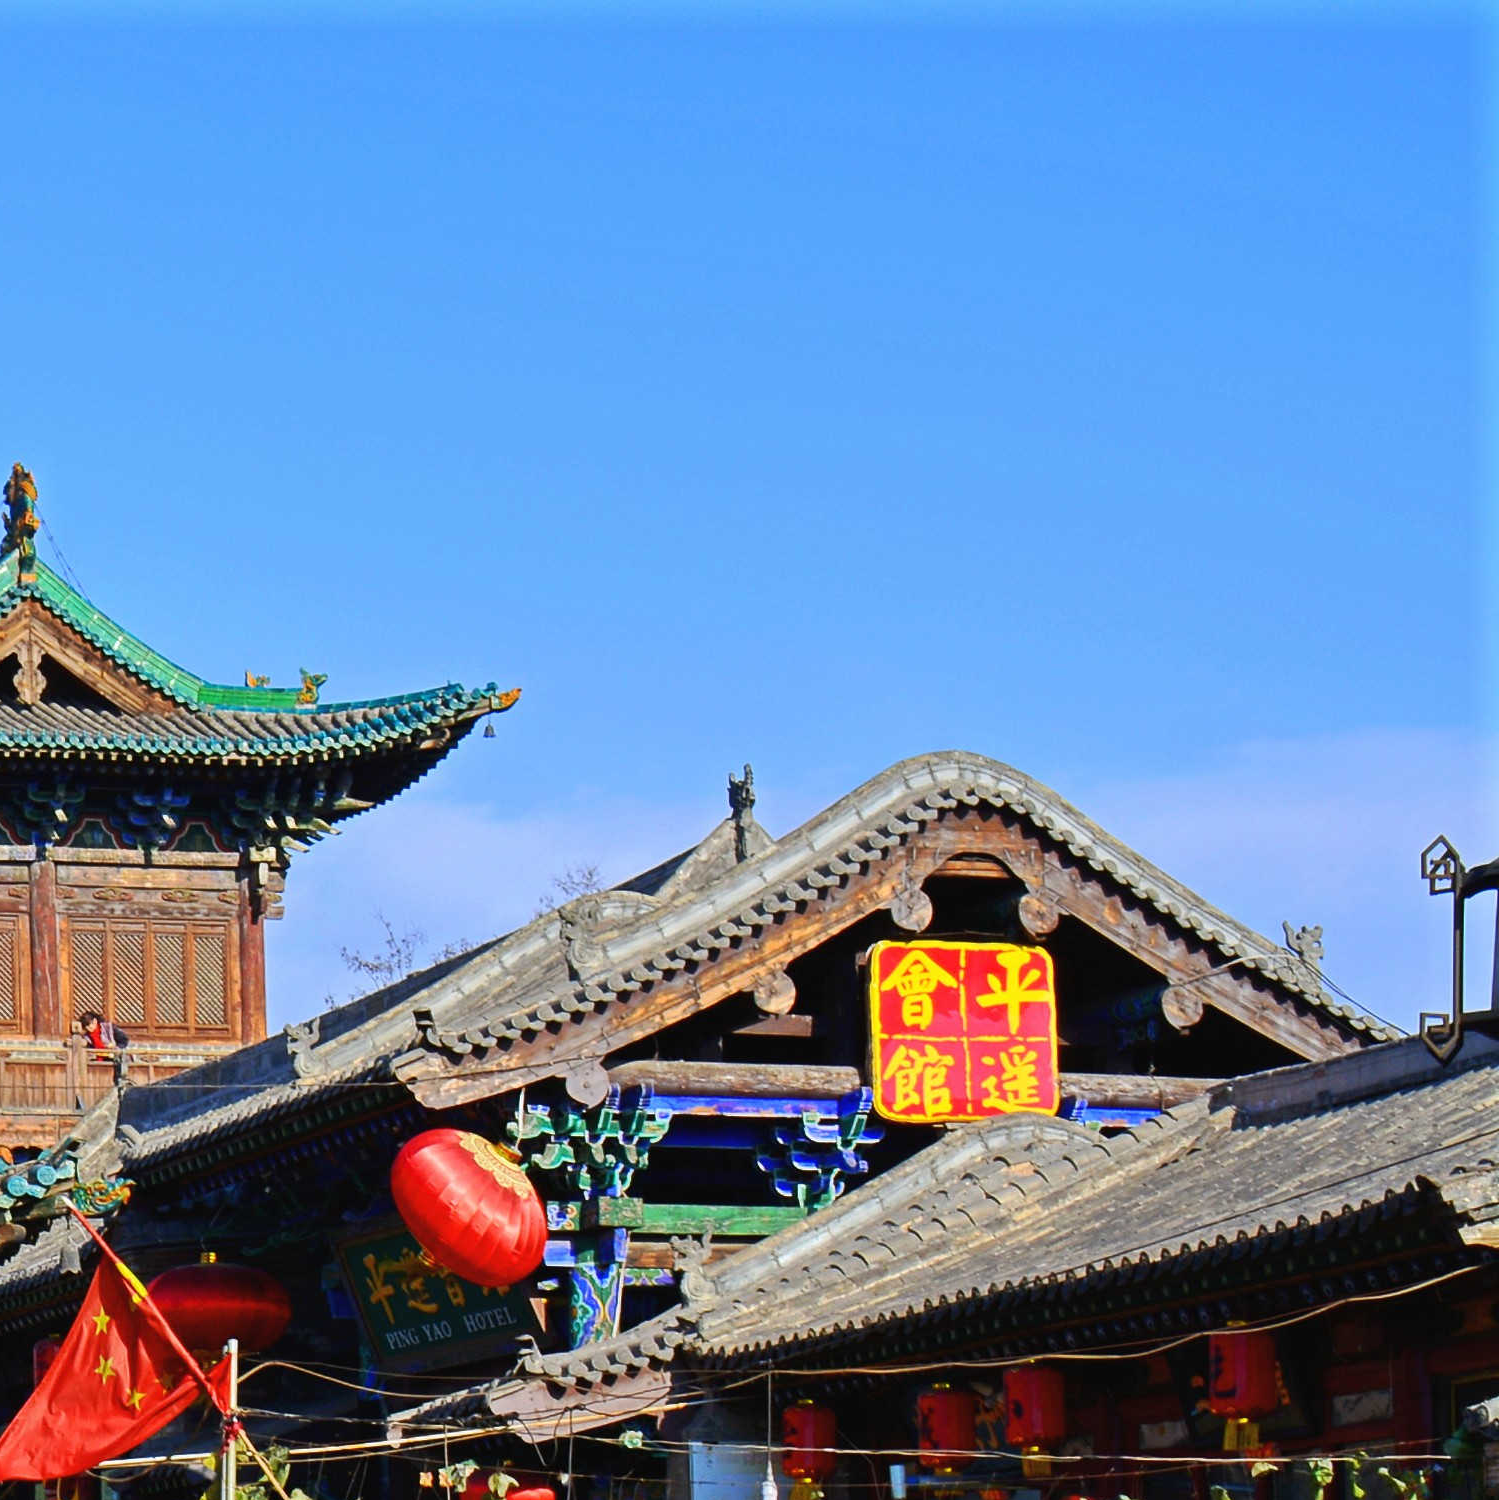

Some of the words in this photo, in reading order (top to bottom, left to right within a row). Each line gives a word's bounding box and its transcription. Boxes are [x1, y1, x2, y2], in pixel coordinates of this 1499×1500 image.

[881, 946, 959, 1117] 會館
[974, 947, 1051, 1114] 平遥
[385, 1328, 420, 1350] PING
[422, 1319, 452, 1342] YAO
[462, 1306, 517, 1334] HOTEL
